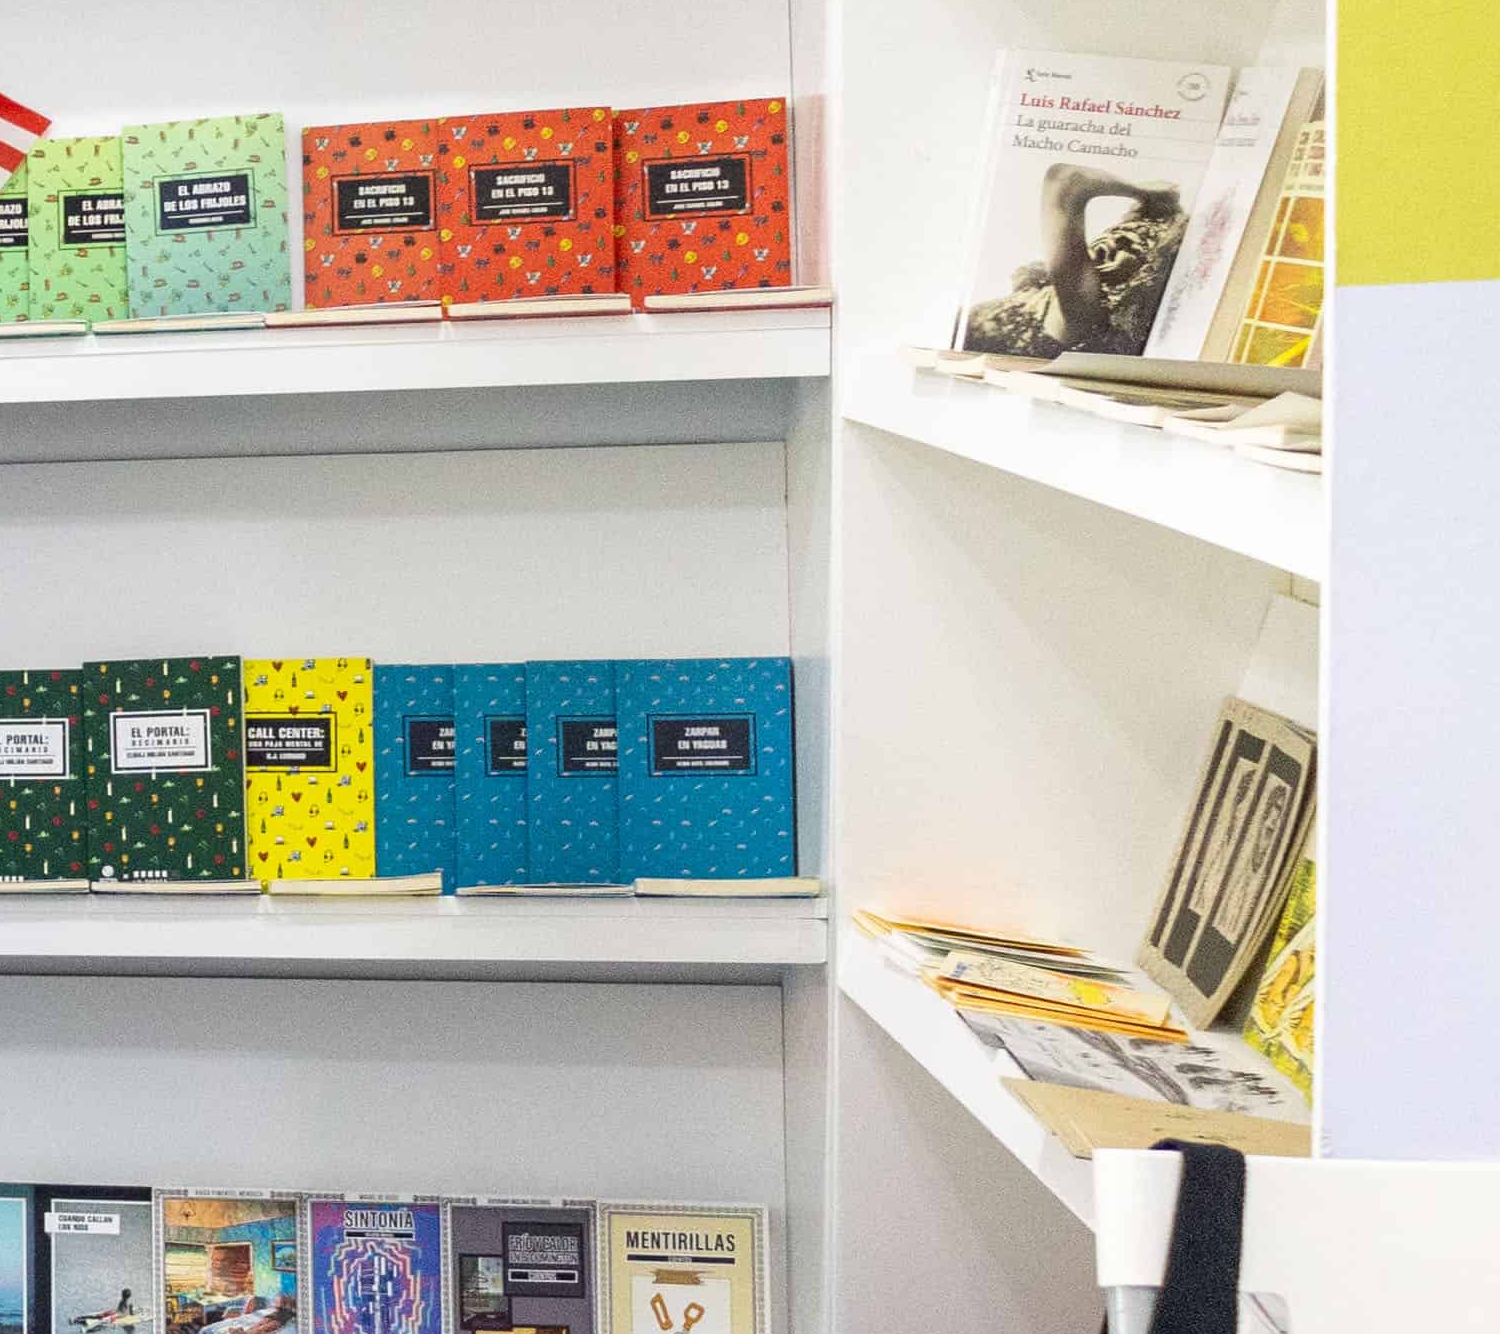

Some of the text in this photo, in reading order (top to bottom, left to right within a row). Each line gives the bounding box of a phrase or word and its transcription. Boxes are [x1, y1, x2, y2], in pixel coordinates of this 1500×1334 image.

[1020, 93, 1181, 120] Luis Rafael Sánchez
[1016, 115, 1132, 137] La guaracha del
[1012, 134, 1139, 159] Macho Camacho
[178, 185, 190, 196] EL
[6, 734, 49, 746] PORTAL:
[130, 726, 190, 738] EL PORTAL:
[247, 727, 325, 739] CALL CENTER:
[344, 1208, 414, 1229] SINTONÍA
[626, 1231, 736, 1252] MENTIRILLAS
